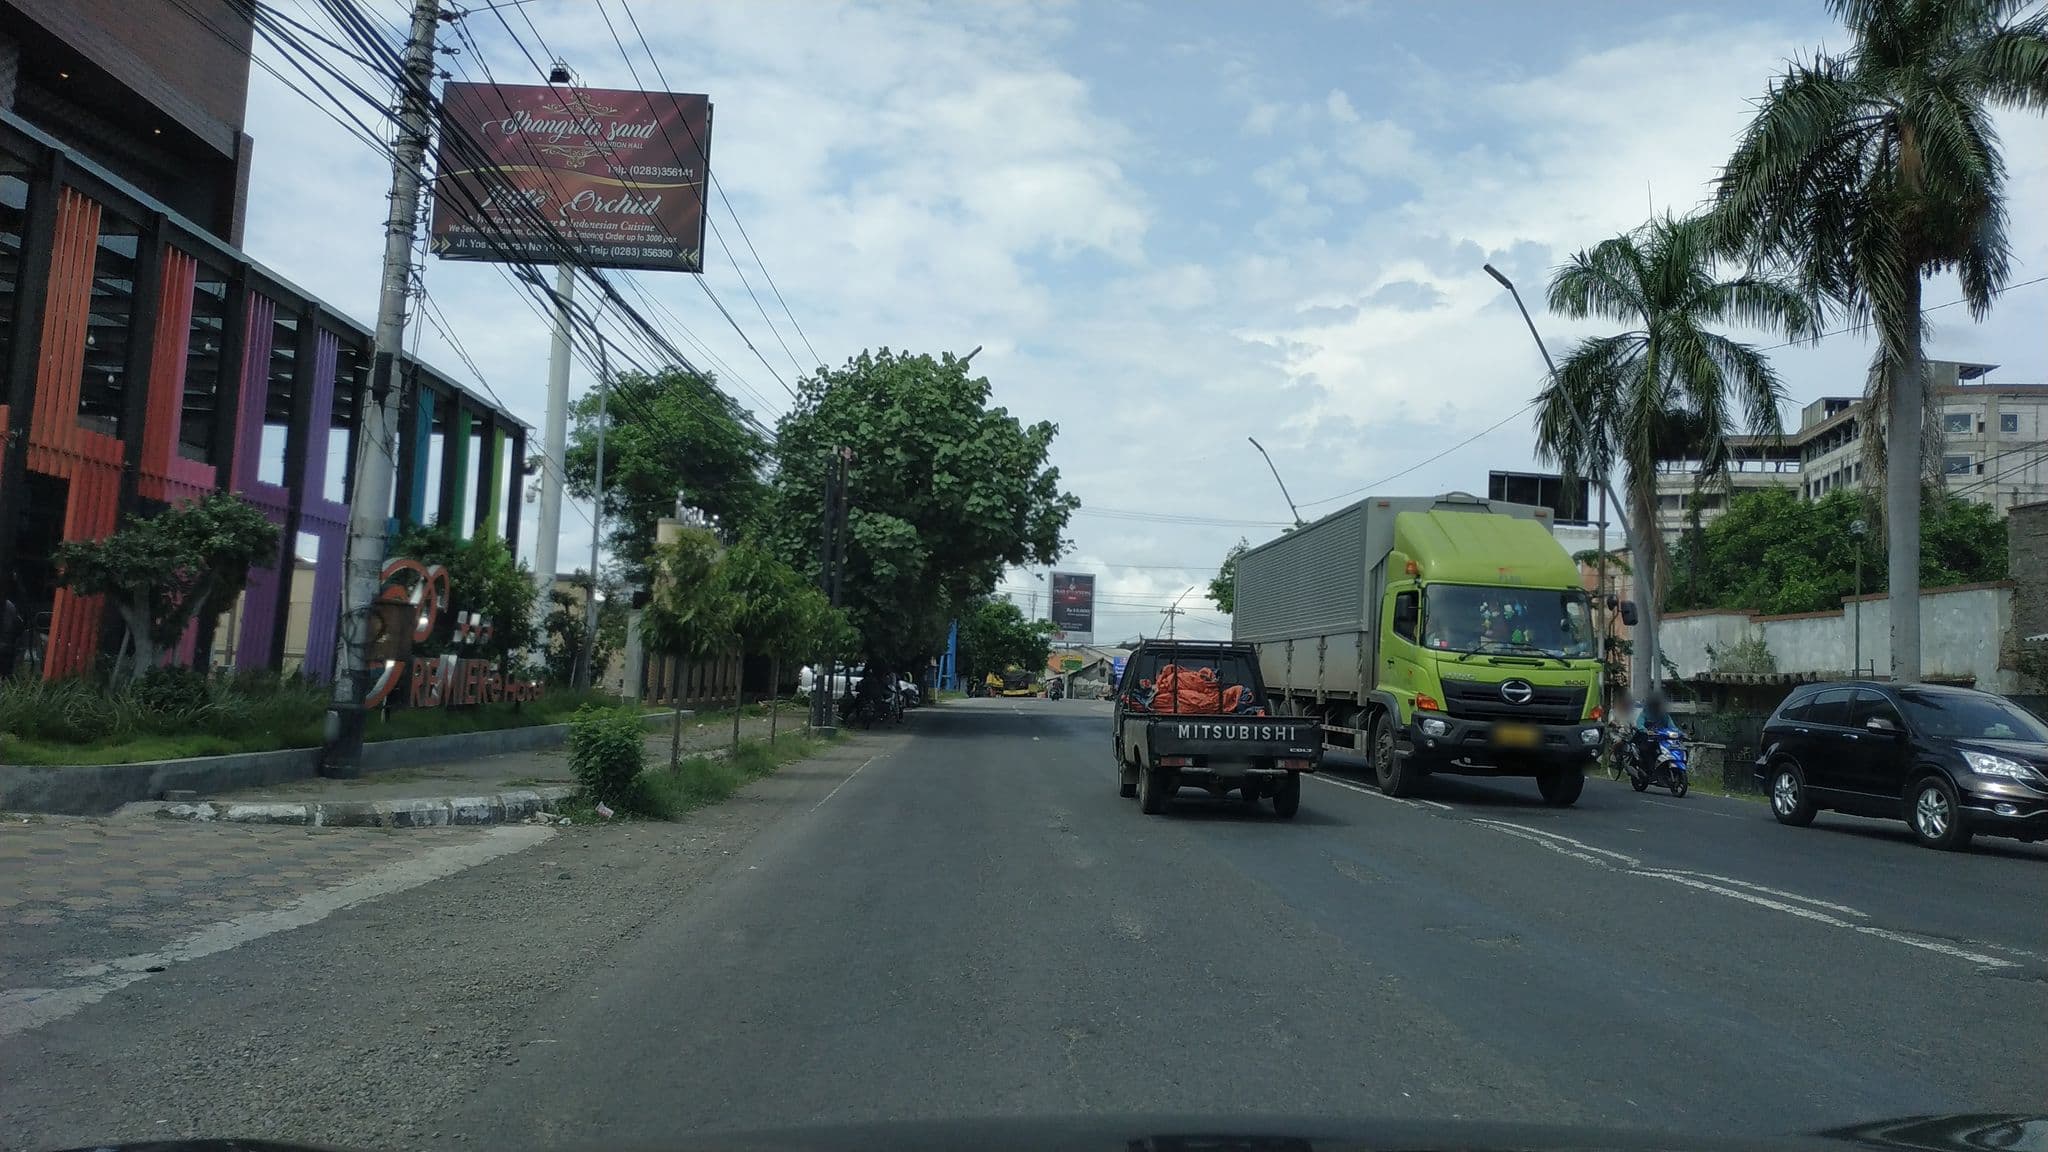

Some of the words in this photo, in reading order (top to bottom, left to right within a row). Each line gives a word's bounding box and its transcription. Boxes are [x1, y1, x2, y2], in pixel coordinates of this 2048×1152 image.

[482, 110, 604, 144] Shangrila
[627, 142, 644, 150] HALL
[559, 189, 662, 217] Orchid
[570, 218, 619, 230] Indonesian
[620, 220, 656, 232] Cuisine
[604, 232, 626, 241] Order
[626, 234, 637, 242] up
[637, 233, 645, 241] to
[469, 239, 487, 249] Yos
[589, 244, 609, 257] Telp
[611, 246, 640, 258] (0283)
[641, 247, 673, 258] 356390
[1178, 725, 1295, 740] MITSUBISHI
